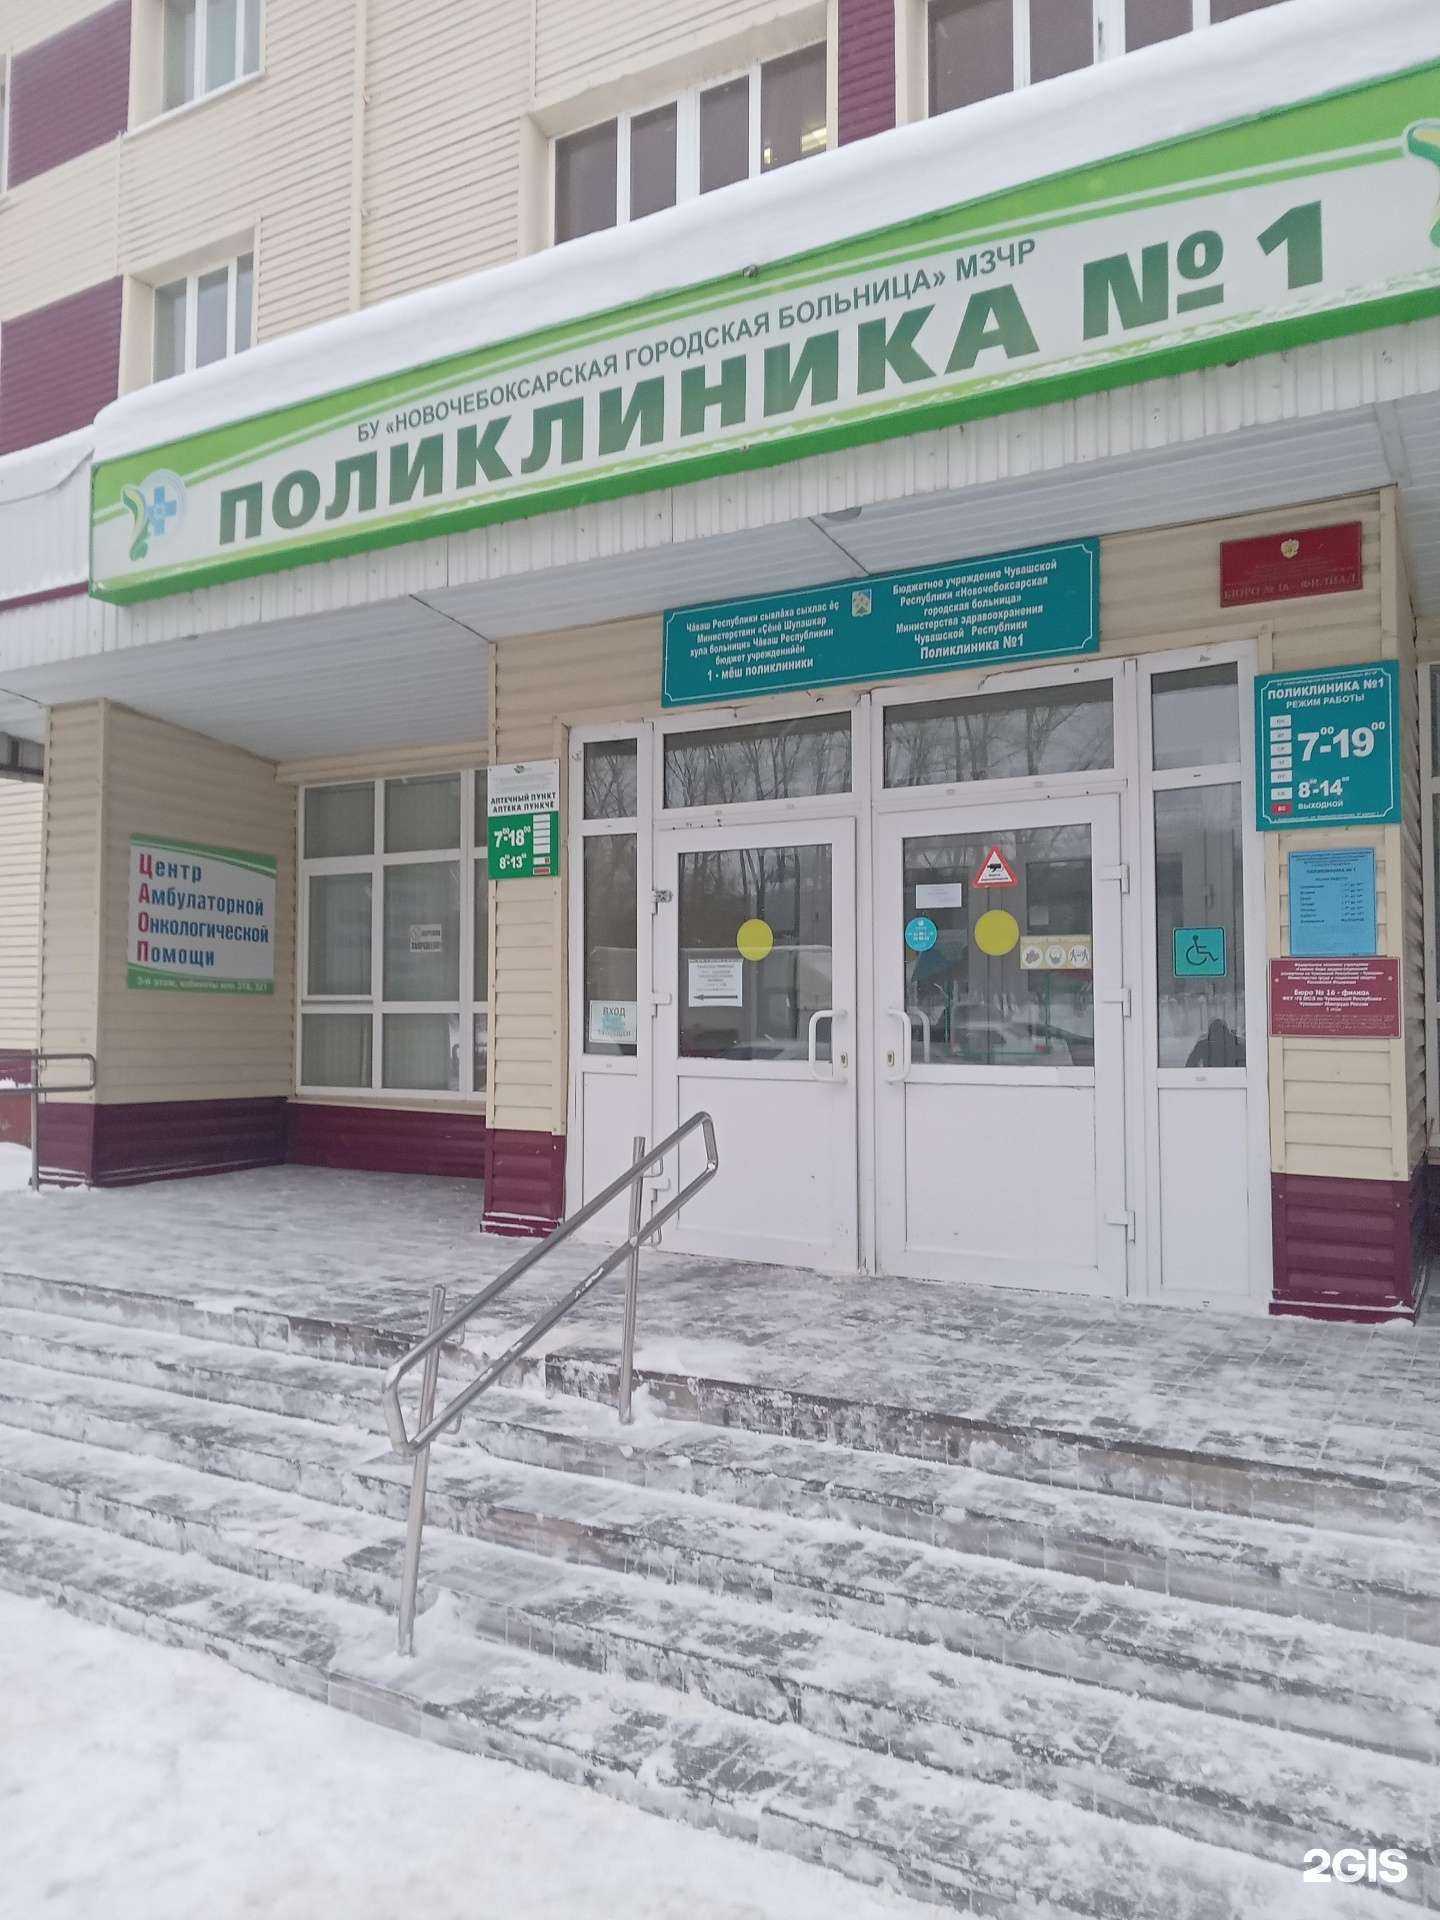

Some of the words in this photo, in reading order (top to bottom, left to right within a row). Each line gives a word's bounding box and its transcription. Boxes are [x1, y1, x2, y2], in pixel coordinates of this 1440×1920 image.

[357, 419, 380, 442] БУ
[385, 353, 618, 434] «НОВОЧЕБОКСАРСКАЯ
[625, 312, 770, 371] ГОРОДСКАЯ
[778, 268, 946, 330] БОЛЬНИЦА»
[955, 238, 1036, 282] МЗЧР
[219, 283, 1041, 546] ПОЛИКЛИНИКА
[1082, 229, 1225, 341] №
[1256, 200, 1323, 290] 1
[893, 580, 943, 595] Бюджетное
[945, 570, 1001, 589] учреждение
[1004, 559, 1057, 576] Чувашской
[900, 591, 953, 607] Республики
[955, 577, 1048, 596] «Новочебоксарская
[924, 602, 969, 616] городская
[972, 594, 1021, 608] больница»
[896, 618, 958, 633] Министерства
[961, 604, 1043, 624] здравоохранения
[914, 629, 965, 645] Чувашской
[971, 620, 1028, 636] Республики
[920, 638, 999, 659] Поликлиника
[708, 670, 712, 682] 1
[746, 658, 813, 676] поликлиники
[1268, 680, 1360, 700] ПОЛИКЛИНИКА
[1286, 697, 1321, 709] РЕЖИМ
[1323, 693, 1365, 705] РАБОТЫ
[493, 803, 521, 813] АПТЕКА
[531, 792, 556, 800] ПУНКТ
[139, 853, 202, 883] Центр
[138, 882, 264, 916] Амбулаторной
[138, 911, 269, 943] Онкологической
[137, 940, 215, 968] Помощи
